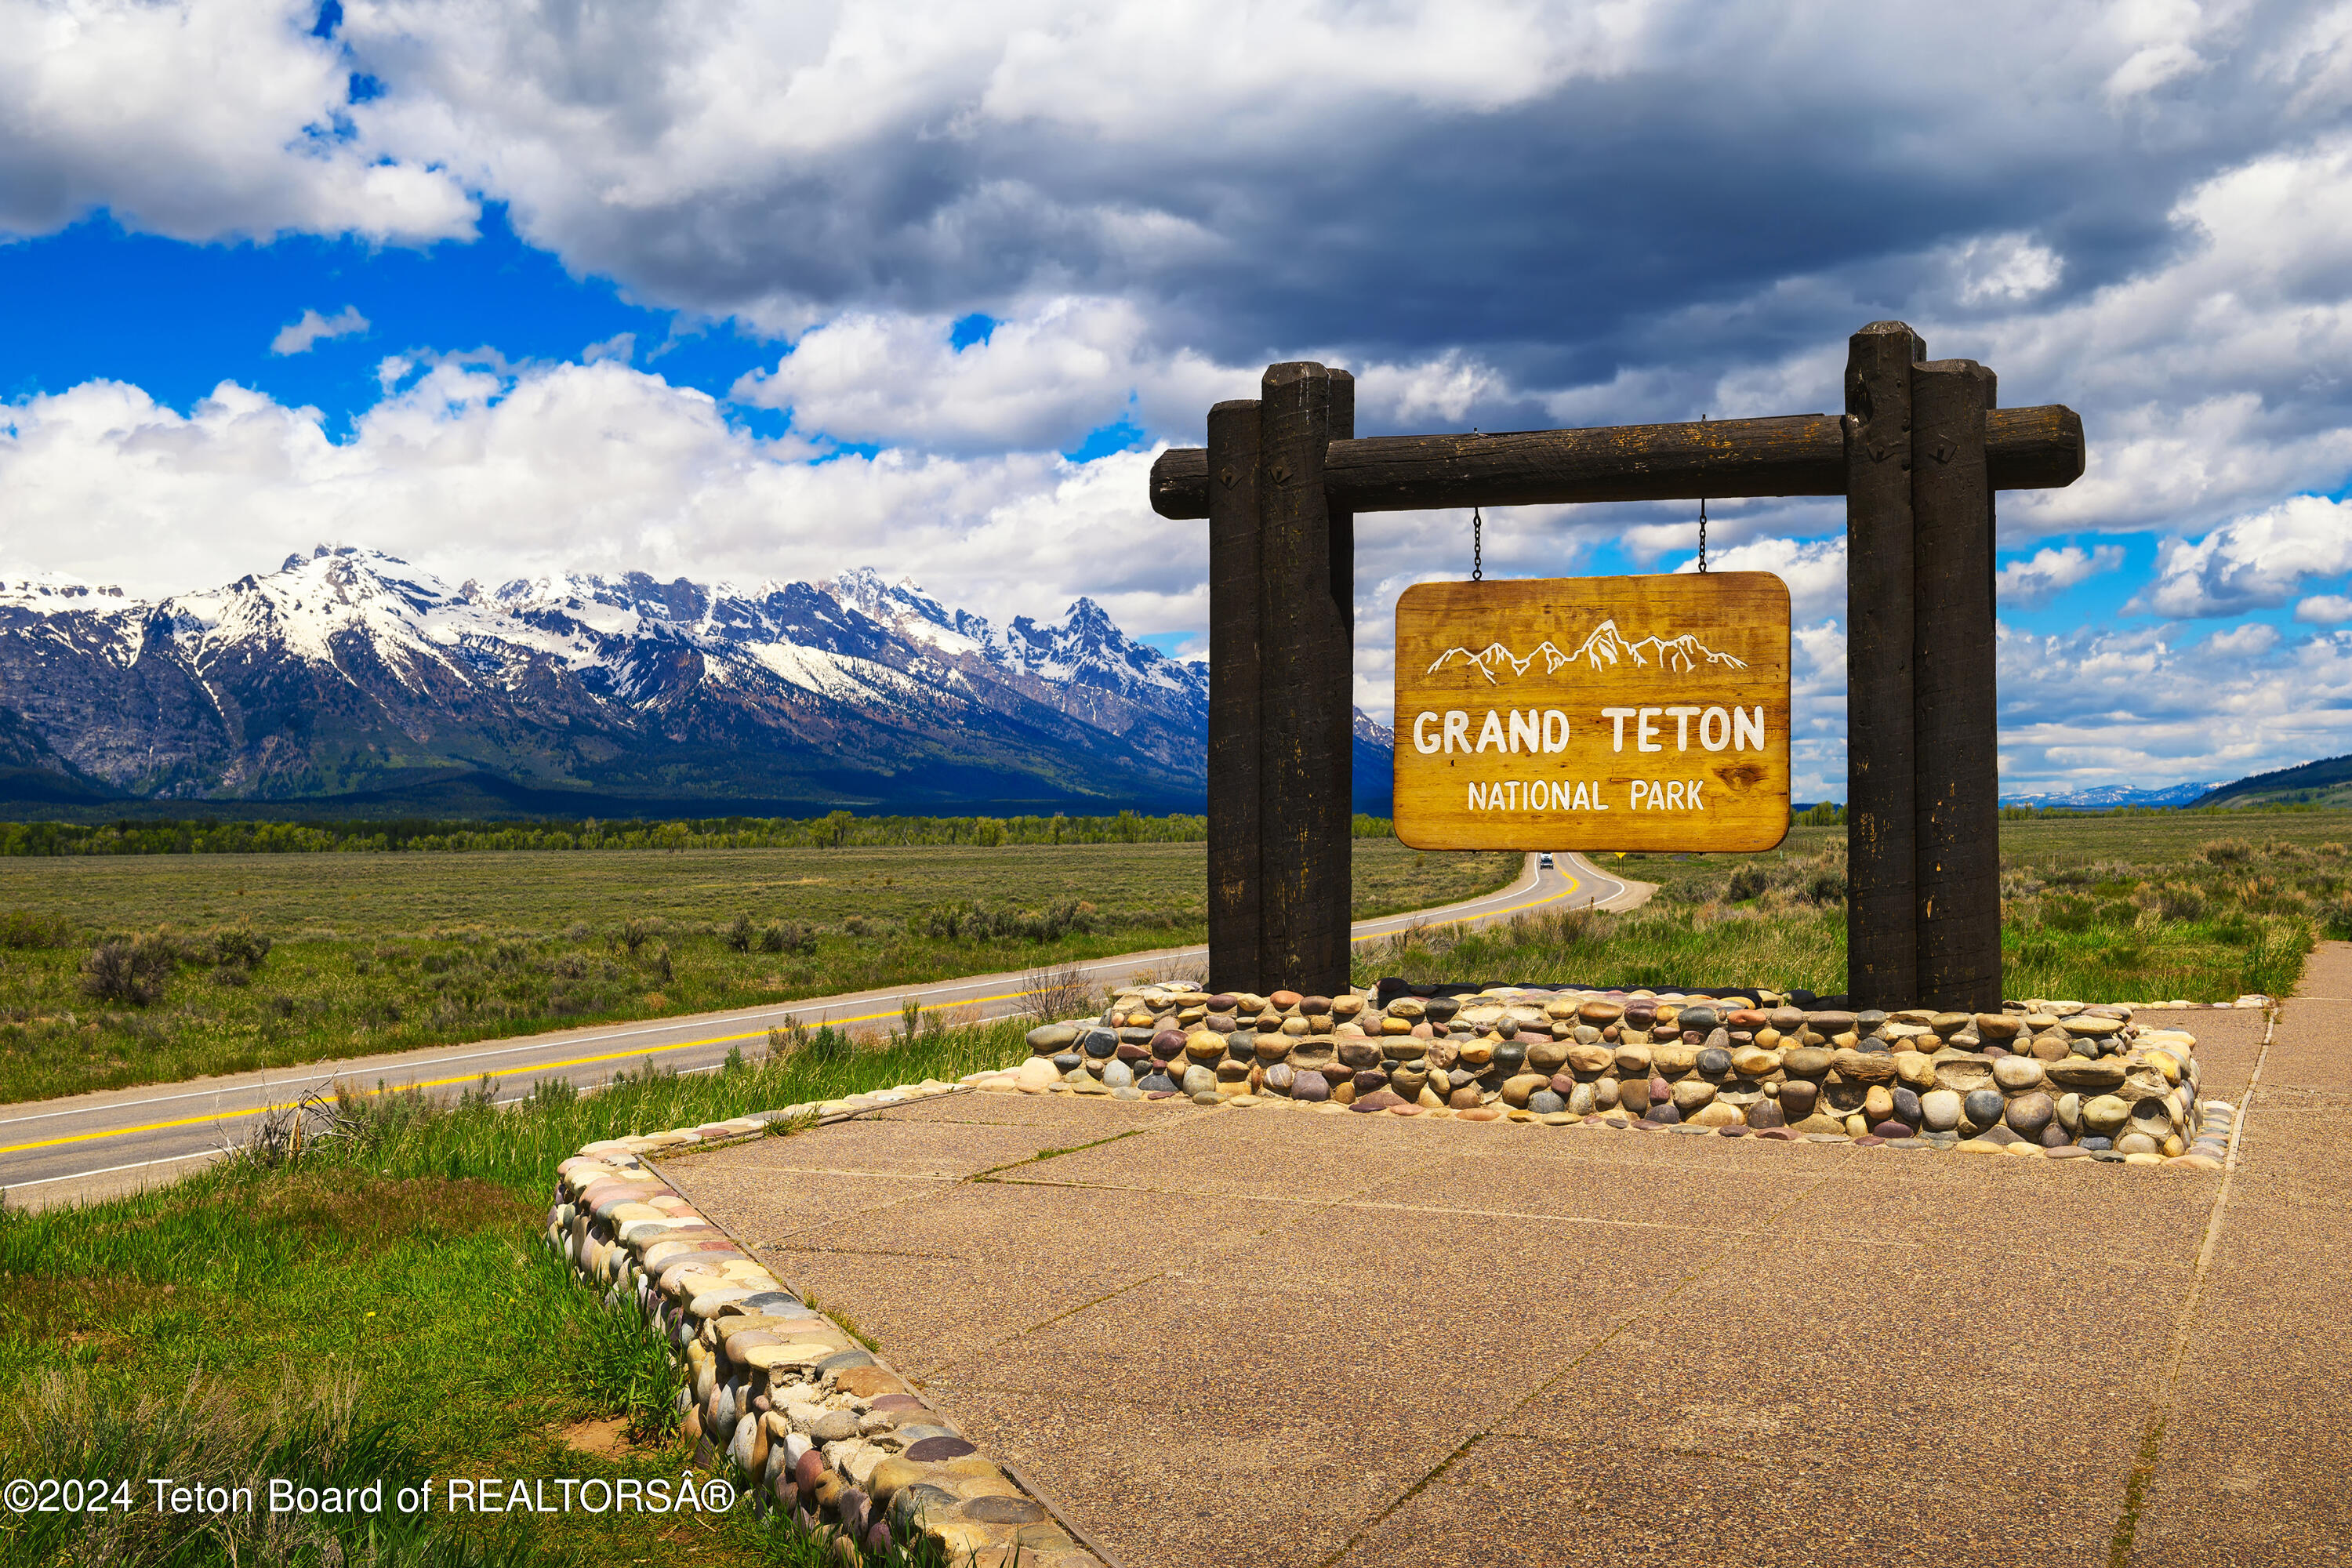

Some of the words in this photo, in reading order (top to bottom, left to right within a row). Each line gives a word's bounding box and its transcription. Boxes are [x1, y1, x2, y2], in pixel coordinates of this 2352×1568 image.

[1413, 708, 1570, 754] GRAND
[1601, 705, 1765, 753] TETON
[1468, 779, 1610, 811] NATIONAL
[1630, 779, 1704, 811] PARK
